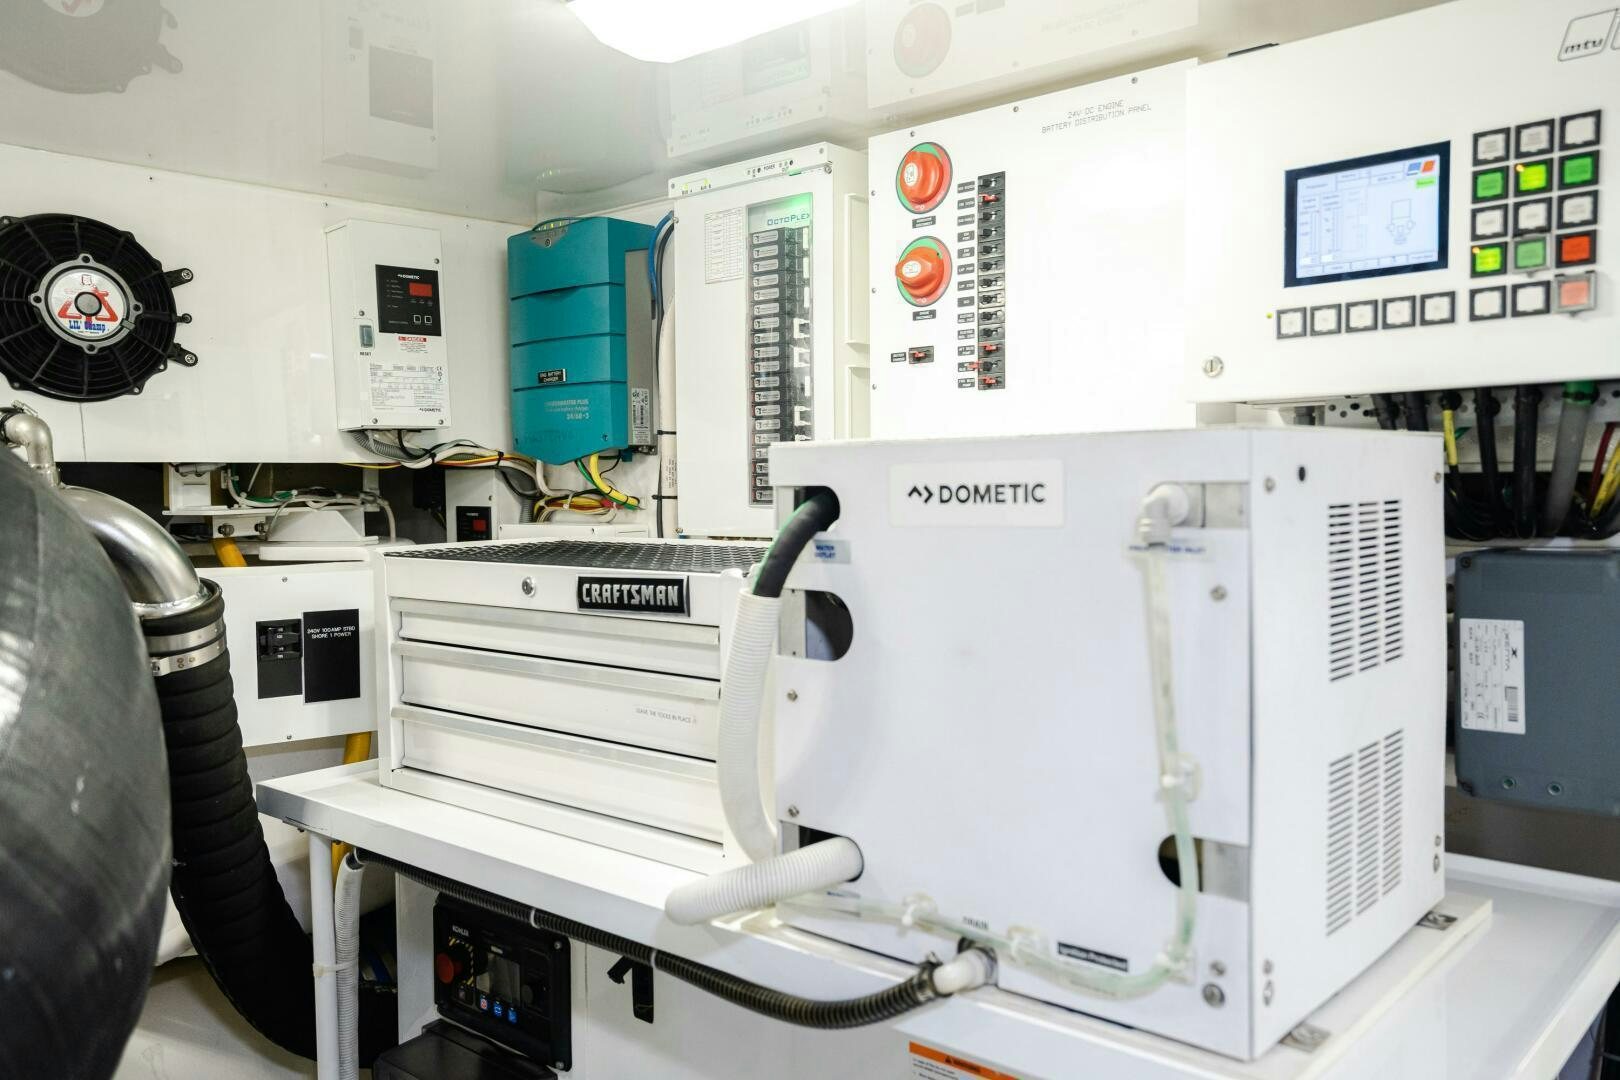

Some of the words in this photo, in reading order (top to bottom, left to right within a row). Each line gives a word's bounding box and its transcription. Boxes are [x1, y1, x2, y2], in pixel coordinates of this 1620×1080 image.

[1565, 38, 1603, 54] mtu
[1041, 121, 1072, 134] BATTERY
[1074, 110, 1125, 126] DISTRIBUTION
[939, 483, 1046, 504] DOMETIC
[582, 583, 679, 607] CRAFTSMAN
